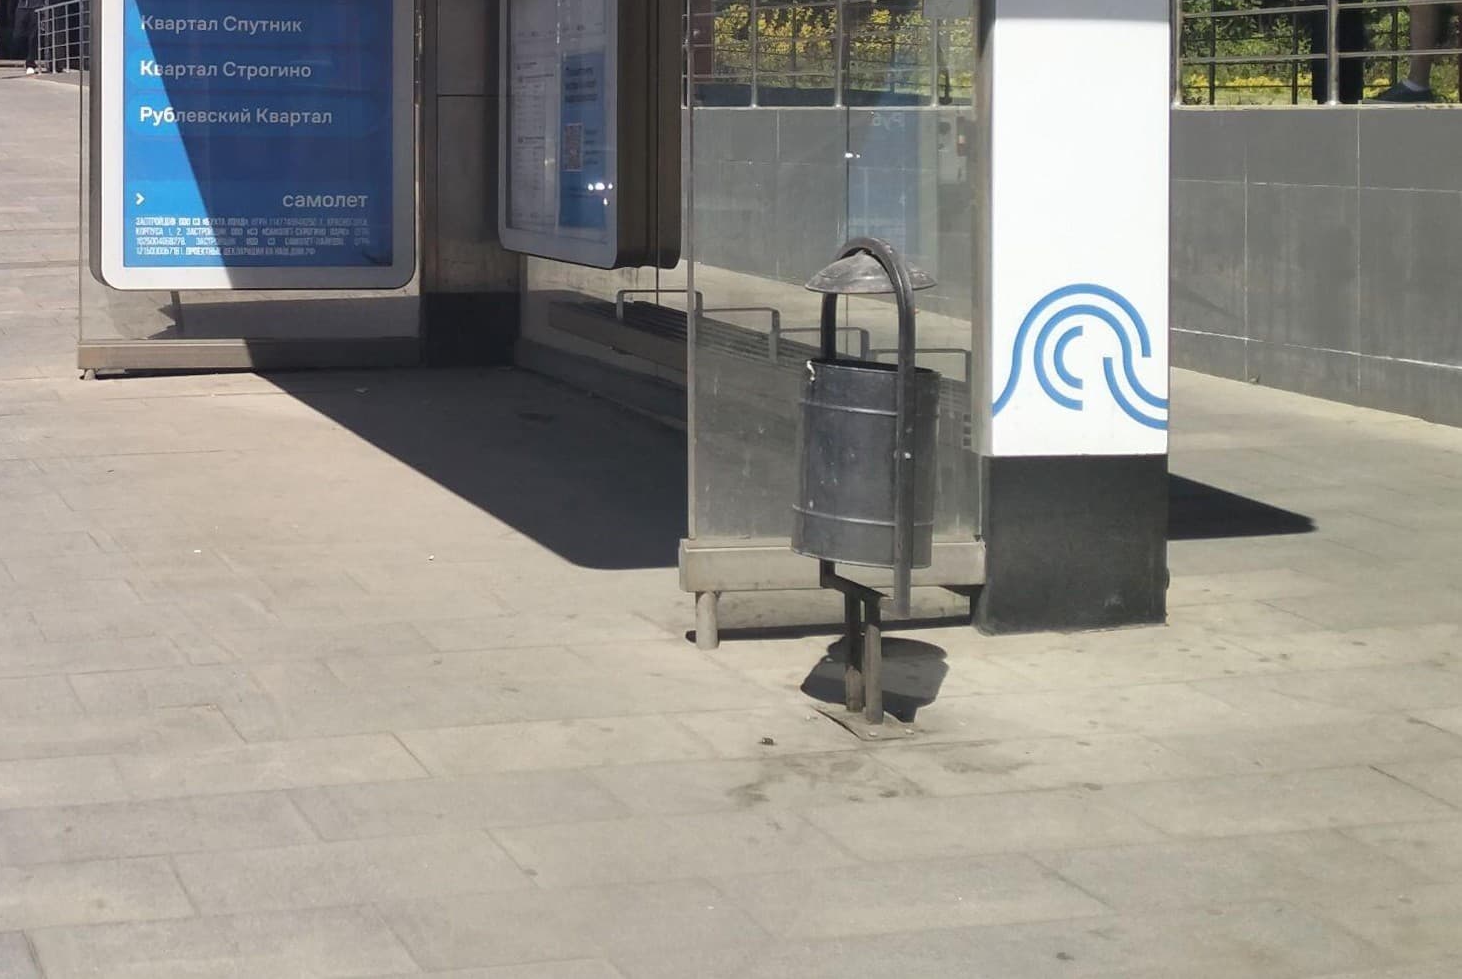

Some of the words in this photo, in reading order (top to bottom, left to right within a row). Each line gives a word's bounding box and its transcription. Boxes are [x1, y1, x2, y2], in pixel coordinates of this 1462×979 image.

[140, 15, 218, 34] Квартал
[223, 15, 302, 35] Спутник
[140, 60, 218, 80] Квартал
[222, 61, 312, 80] Строгино
[140, 106, 251, 127] Рублевский
[256, 108, 333, 127] Квартал
[282, 194, 369, 209] самолет
